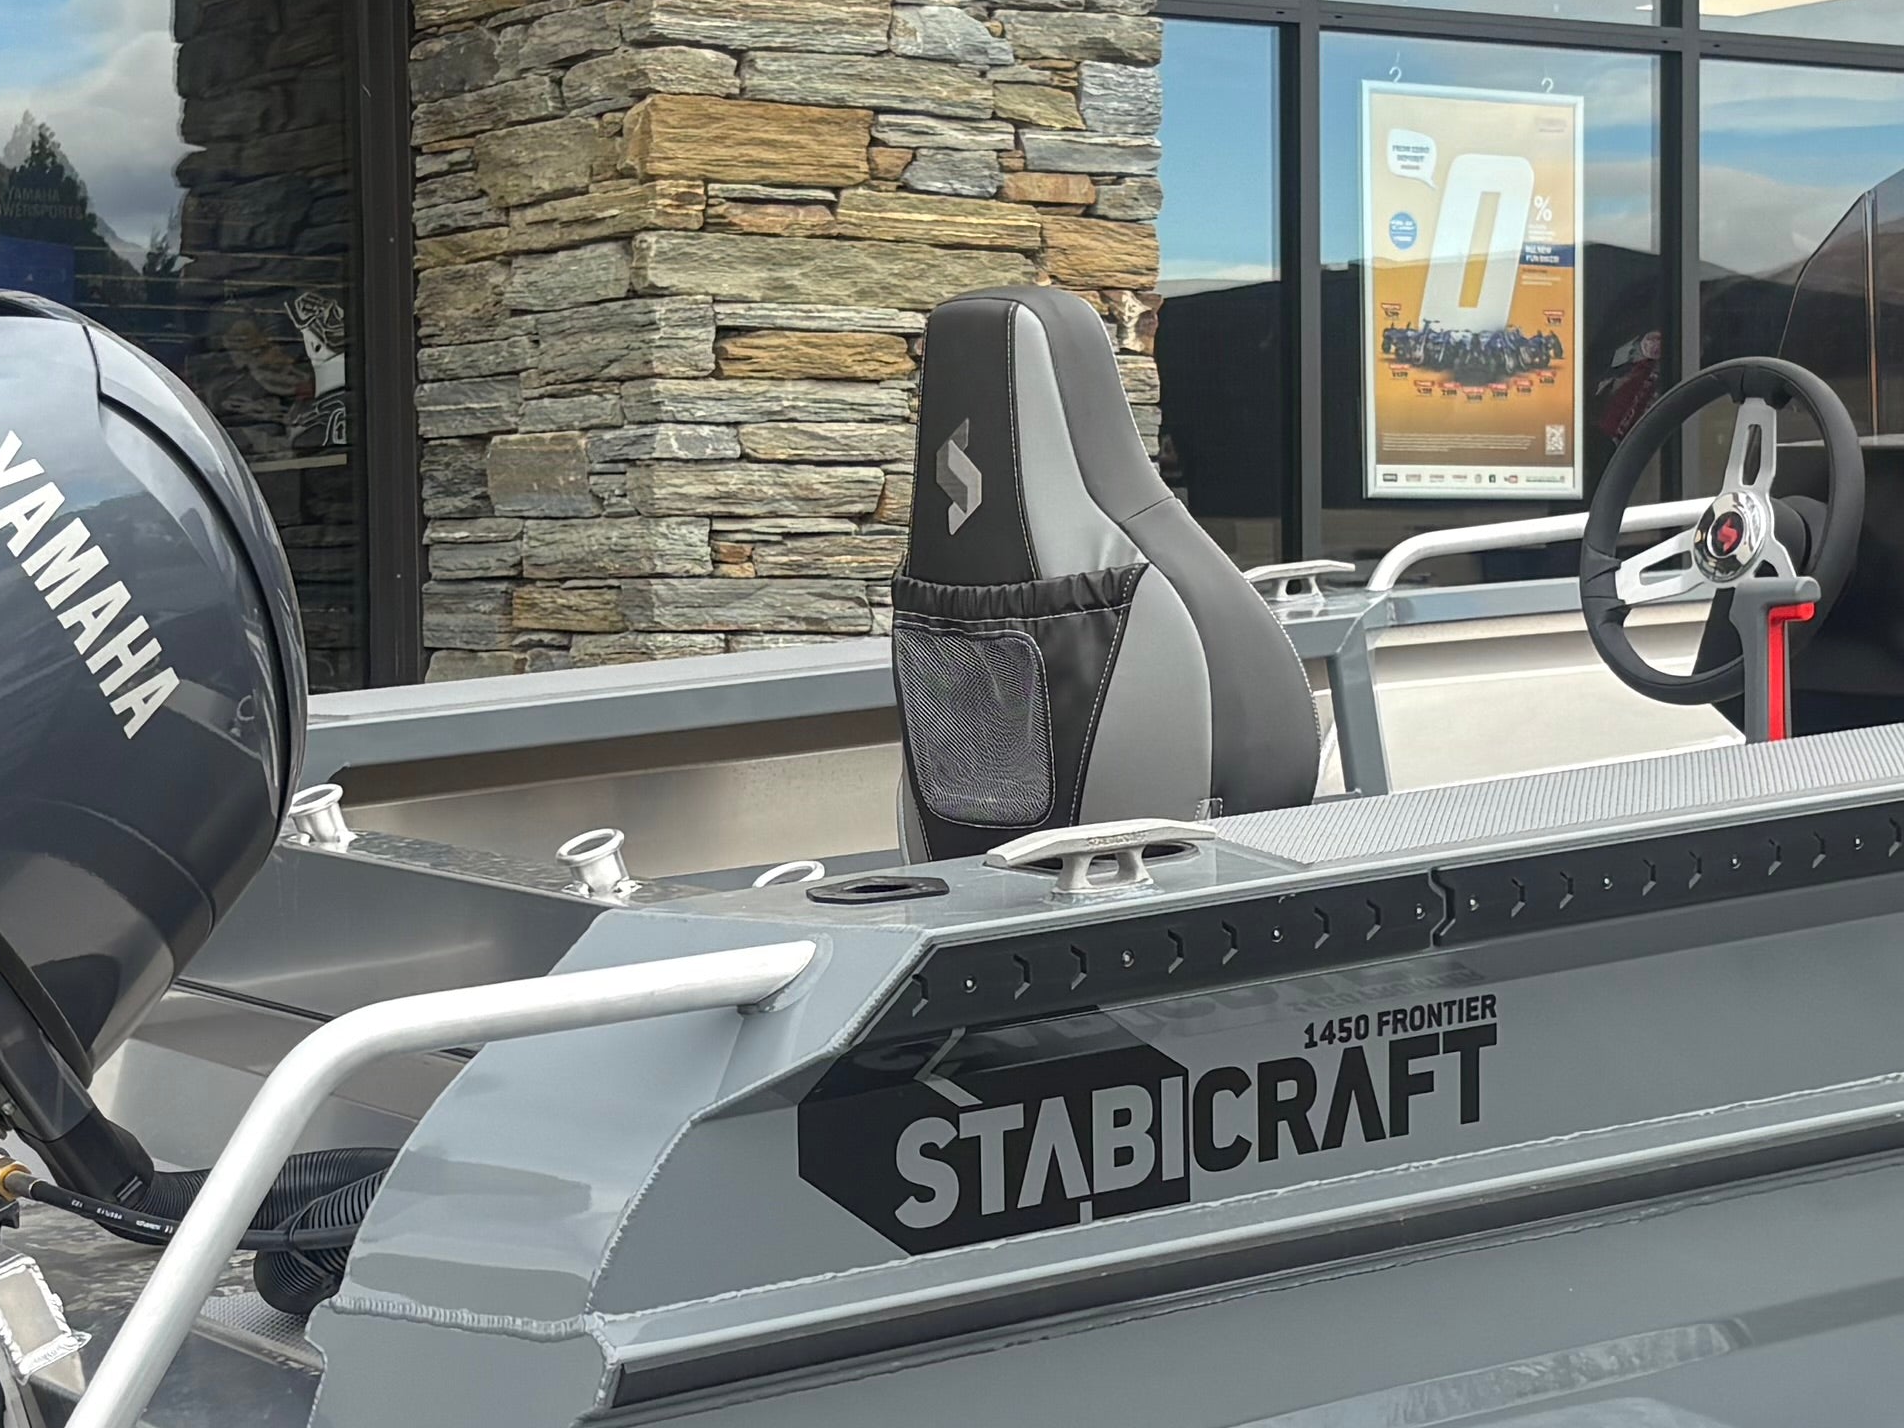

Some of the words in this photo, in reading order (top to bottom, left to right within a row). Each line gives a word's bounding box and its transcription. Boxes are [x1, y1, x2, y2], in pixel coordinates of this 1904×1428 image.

[1303, 1013, 1370, 1050] 1450
[1377, 993, 1498, 1038] FRONTIER
[893, 1022, 1499, 1230] STABICRAFT
